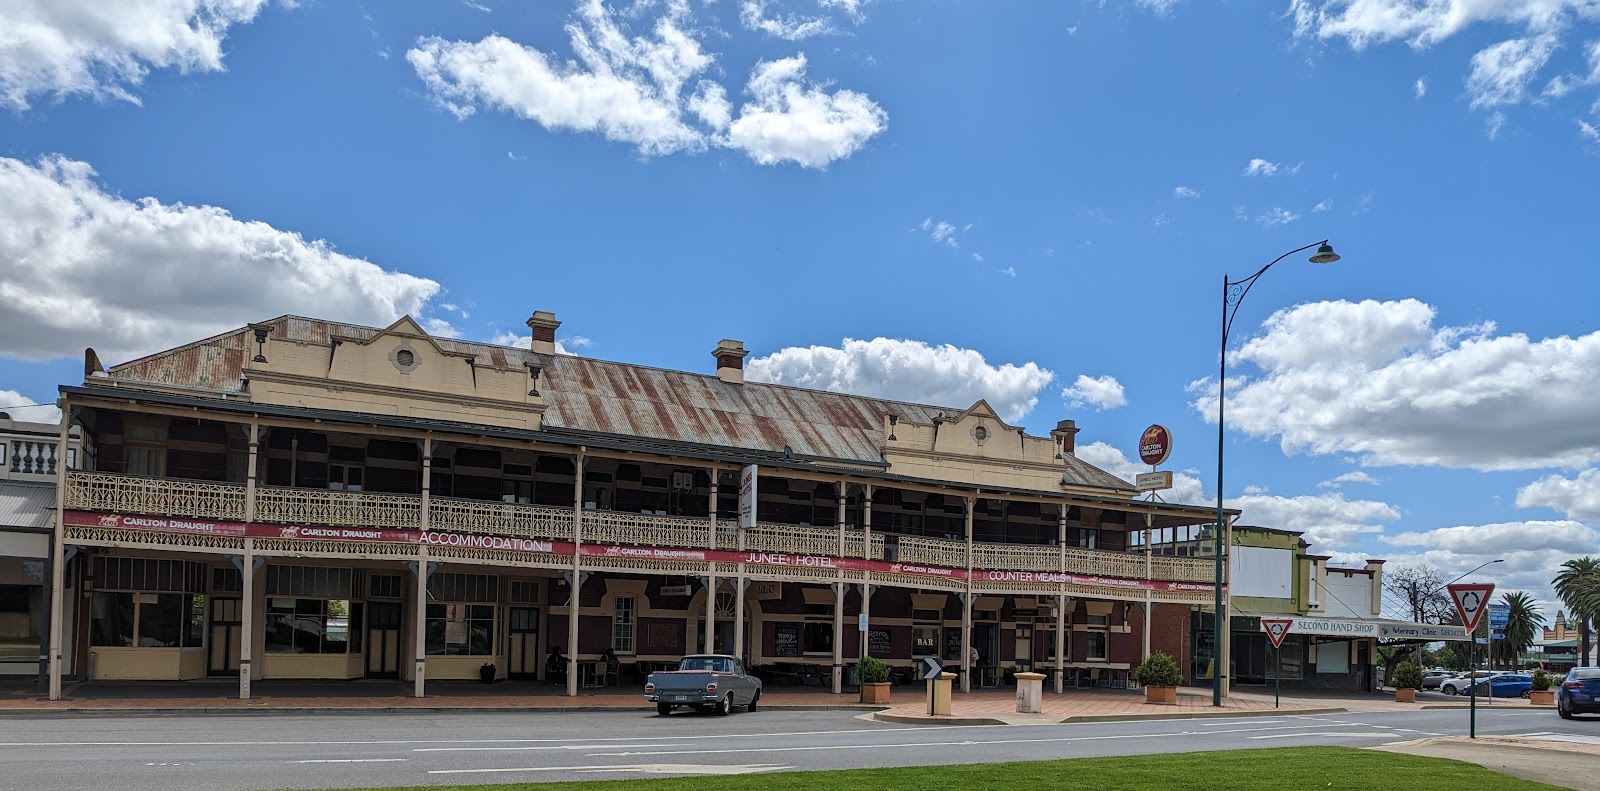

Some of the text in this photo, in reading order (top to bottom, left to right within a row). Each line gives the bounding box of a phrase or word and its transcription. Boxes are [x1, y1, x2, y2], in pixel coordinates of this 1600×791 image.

[1141, 443, 1162, 451] CARLTON
[1141, 448, 1164, 457] DRAUGHT
[123, 517, 215, 531] CARLTON DRAUGHT
[300, 528, 382, 539] CARLTON DRAUGHT
[418, 531, 544, 552] ACCOMMODATION
[621, 548, 686, 558] CARLTON DRAUGHT
[745, 552, 837, 568] JUNEE HOTEL
[902, 565, 953, 575] CARLTON DRAUGHT
[989, 570, 1066, 583] COUNTER MEALS
[1298, 620, 1374, 633] SECOND HAND SHOP
[1392, 627, 1419, 637] Veterinary
[1421, 628, 1437, 636] Clinic
[917, 638, 934, 646] BAR
